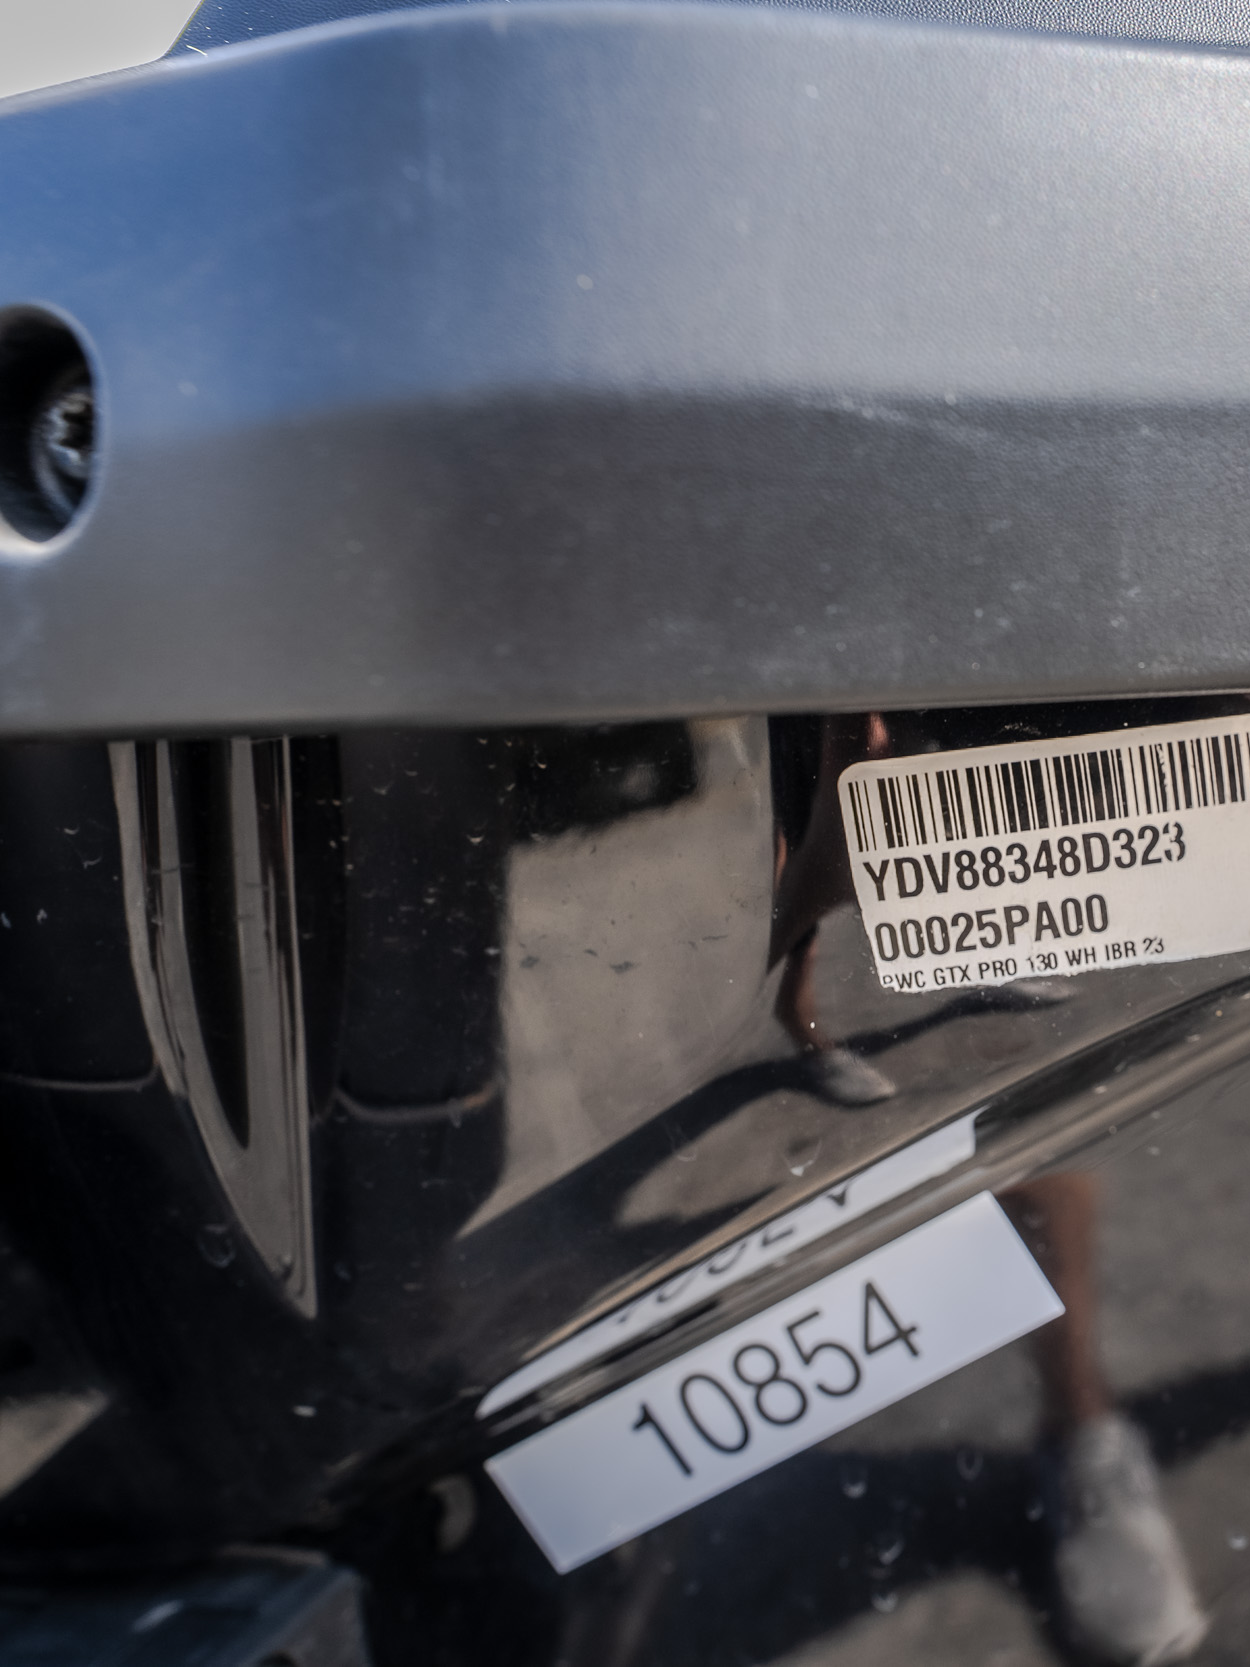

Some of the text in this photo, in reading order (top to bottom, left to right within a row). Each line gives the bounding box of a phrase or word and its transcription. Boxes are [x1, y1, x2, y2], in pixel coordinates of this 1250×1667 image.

[863, 822, 1187, 902] YDV88348D323
[875, 894, 1110, 962] 00025PA00
[933, 964, 971, 986] GTX
[978, 958, 1018, 980] PRO
[1026, 952, 1059, 974] 130
[1067, 946, 1097, 967] WH
[1105, 941, 1137, 961] IBR
[632, 1280, 920, 1478] 10854
